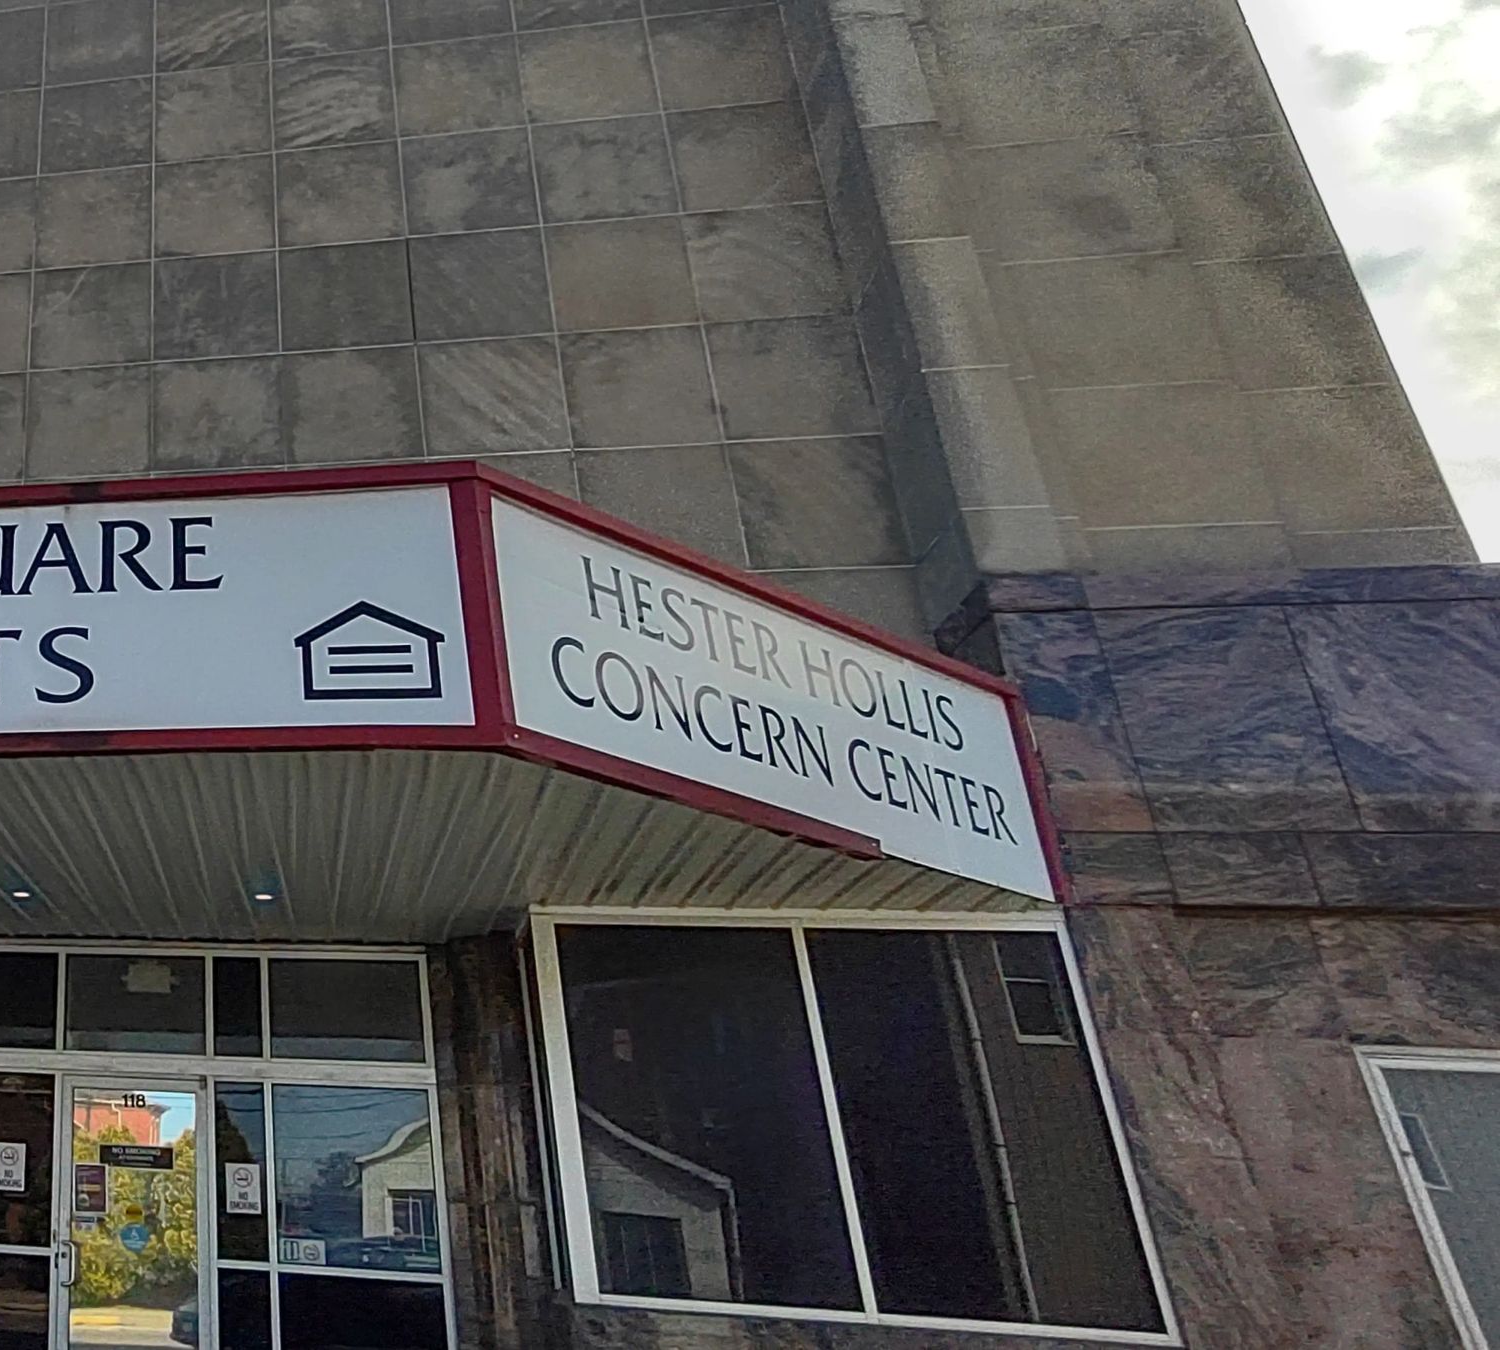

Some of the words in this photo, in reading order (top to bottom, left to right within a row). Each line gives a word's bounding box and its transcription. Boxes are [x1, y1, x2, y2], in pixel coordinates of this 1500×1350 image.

[581, 554, 792, 688] HESTER
[798, 639, 964, 752] HOLLIS
[551, 636, 835, 787] CONCERN
[846, 737, 1018, 846] CENTER
[122, 1093, 146, 1108] 118
[4, 1169, 13, 1178] NO
[238, 1191, 248, 1200] NO
[229, 1200, 259, 1211] SMOKING
